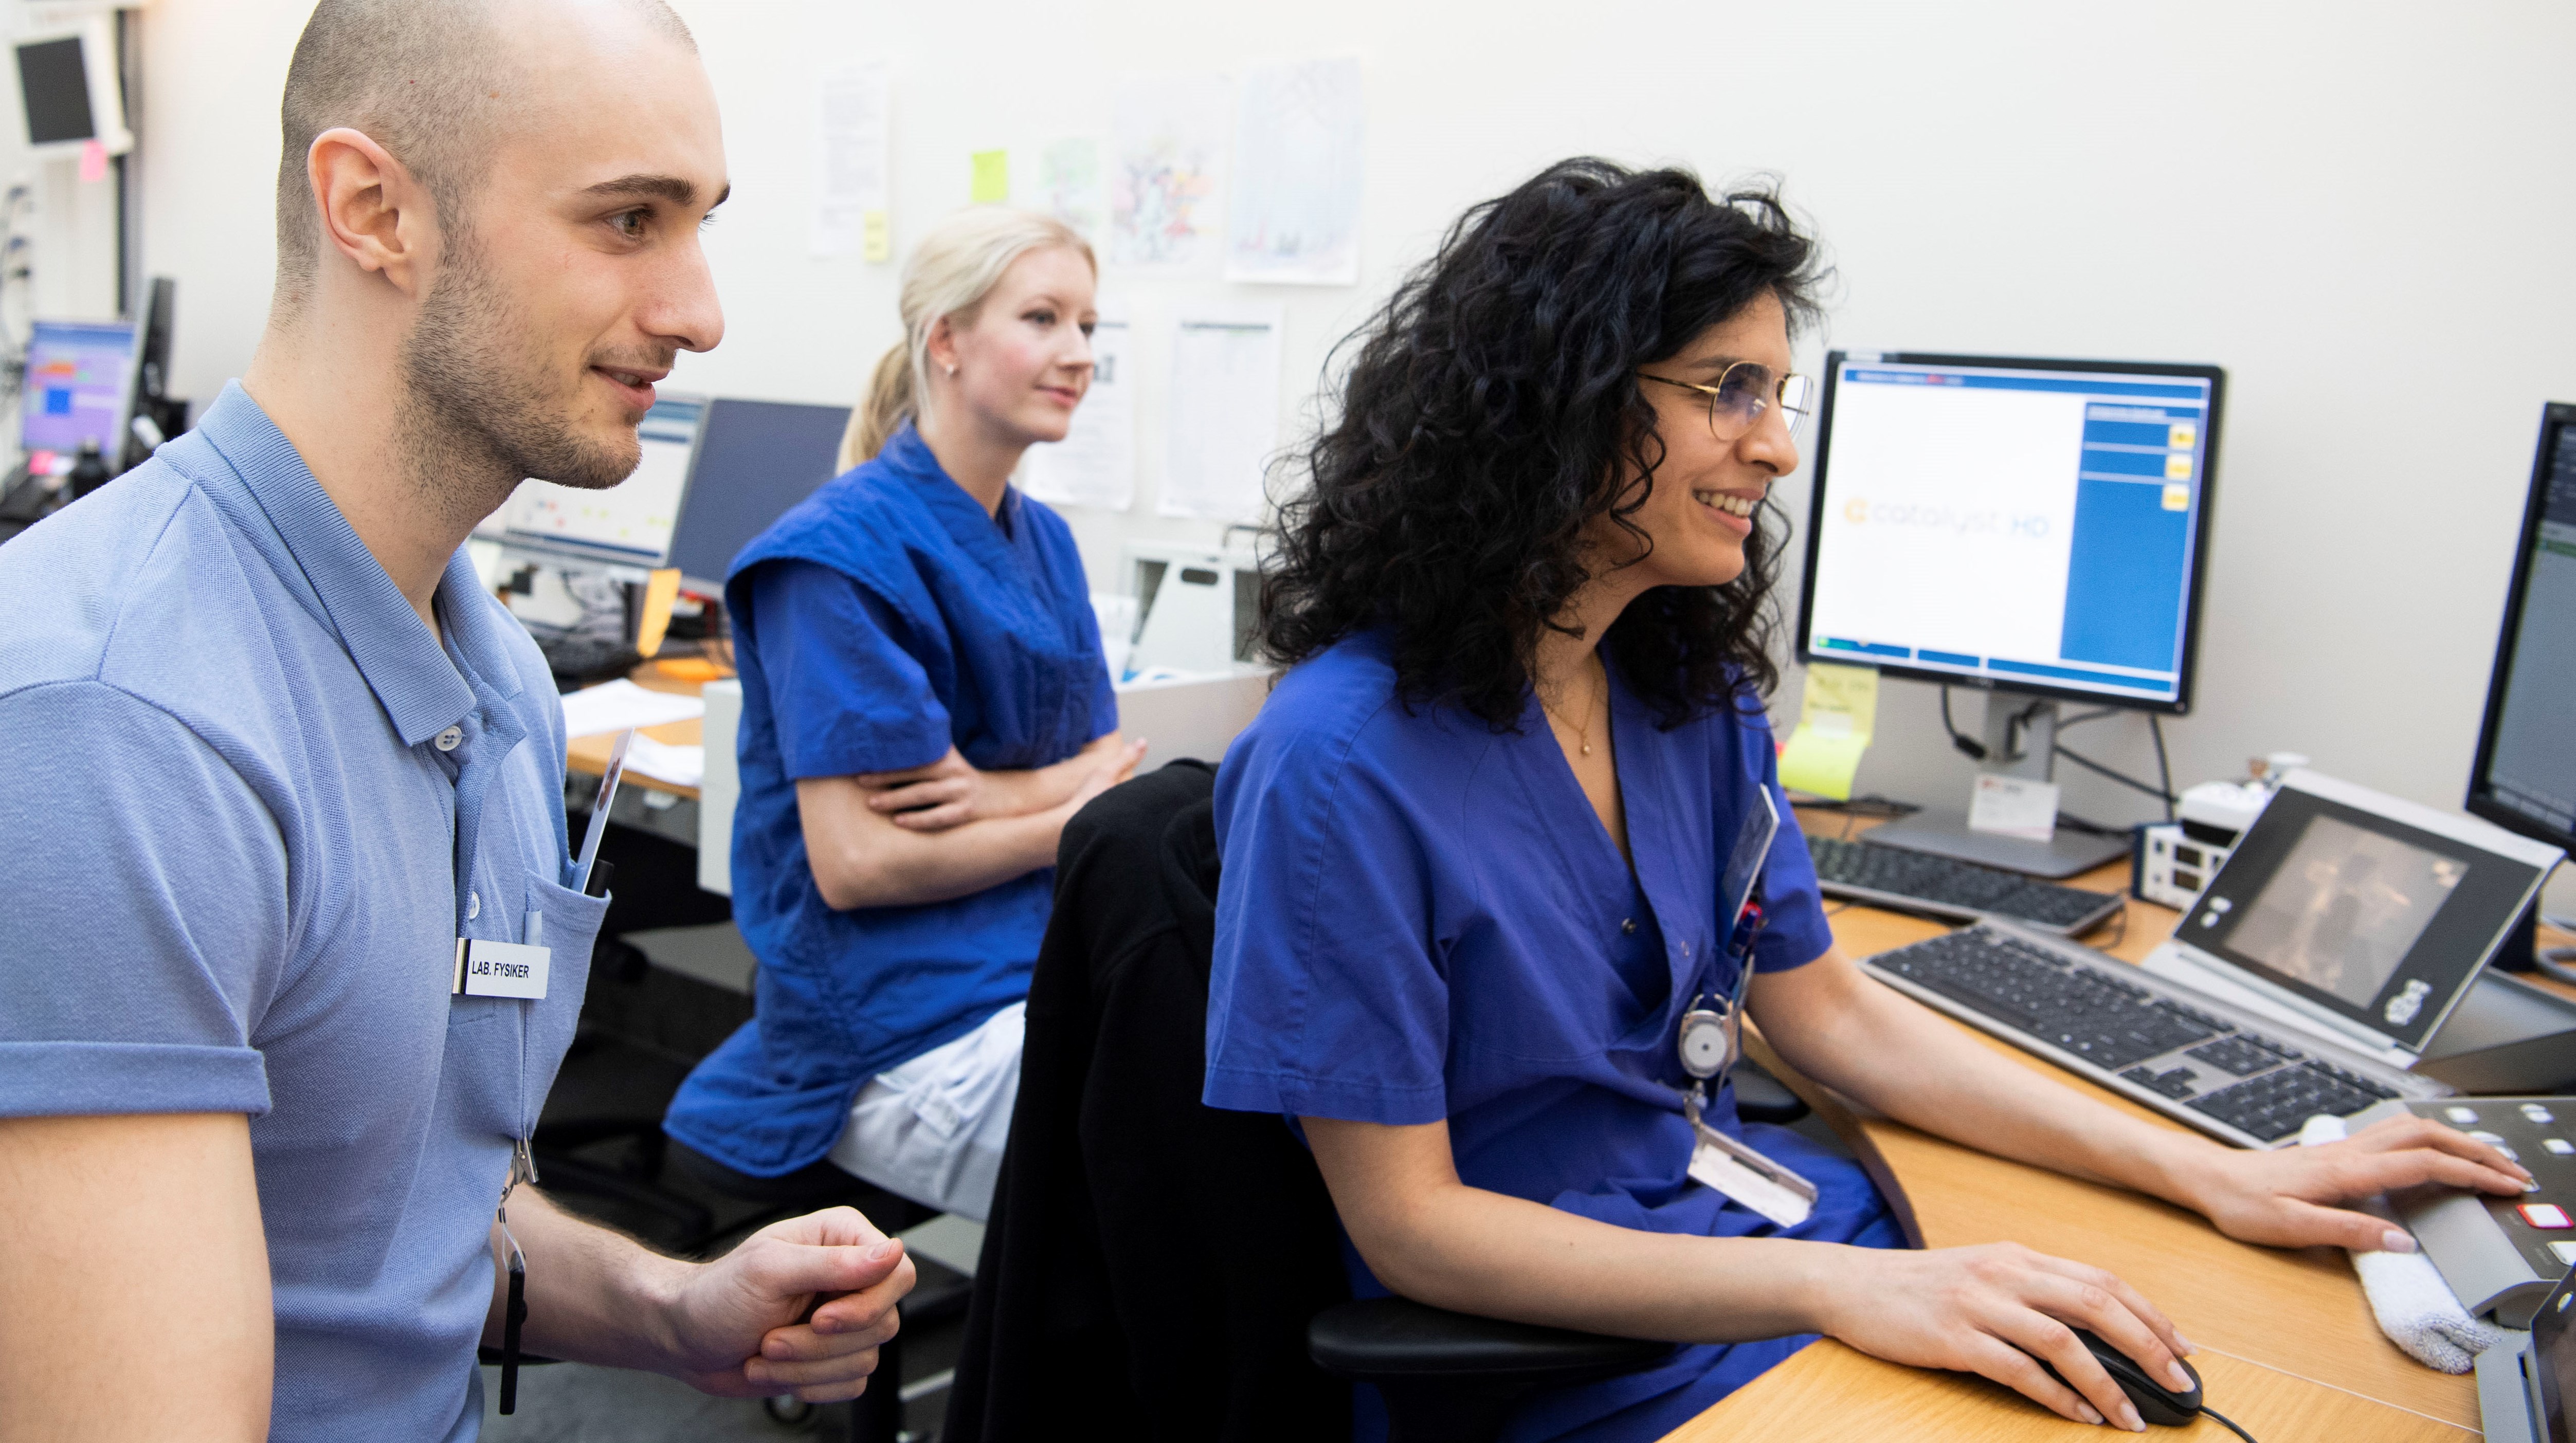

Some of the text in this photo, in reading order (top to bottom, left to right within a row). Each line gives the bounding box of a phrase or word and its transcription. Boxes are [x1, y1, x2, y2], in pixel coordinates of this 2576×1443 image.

[2010, 513, 2051, 538] HD
[472, 961, 529, 978] LAB. FYSIKER
